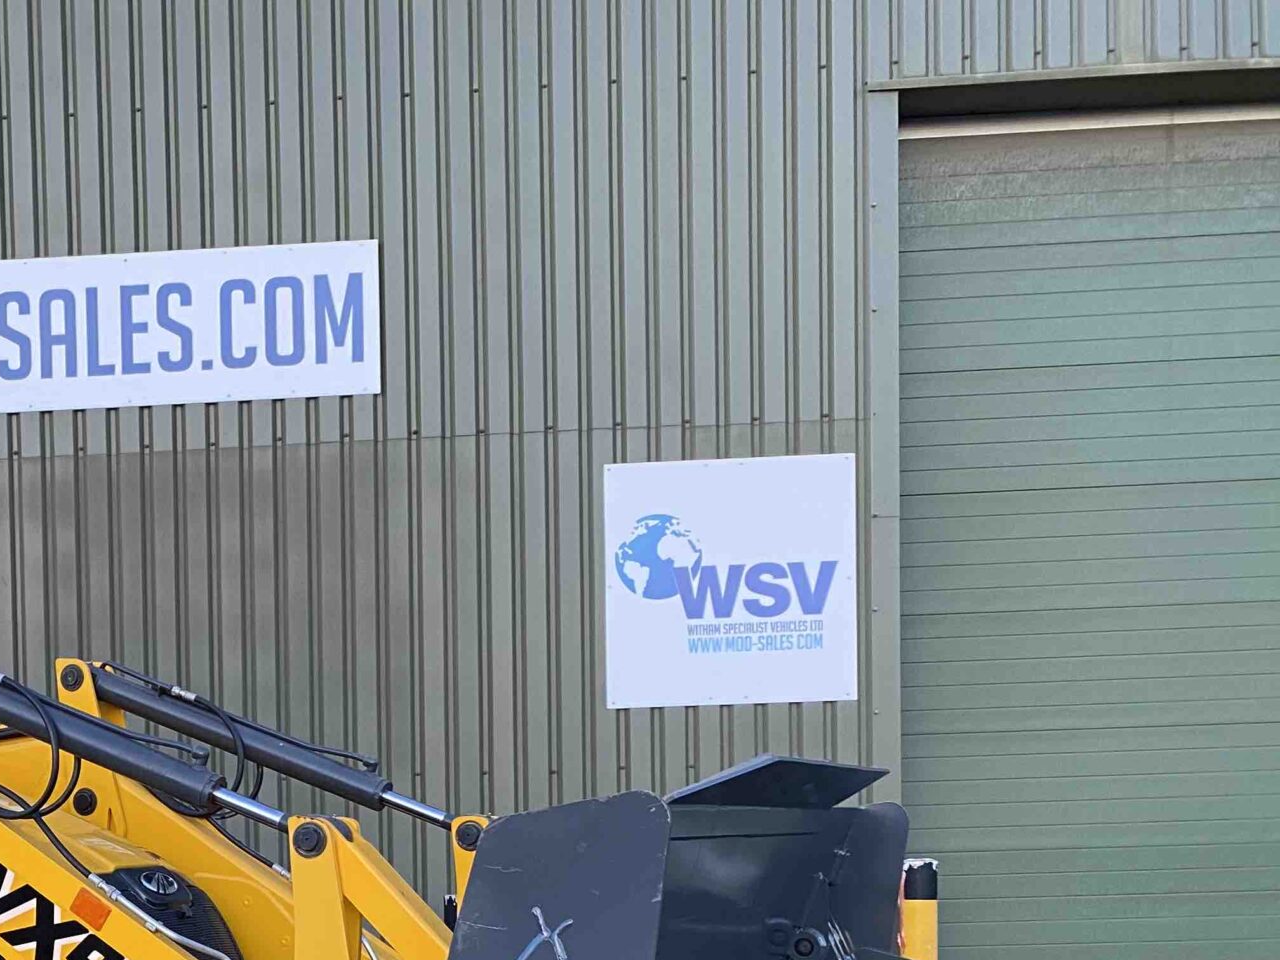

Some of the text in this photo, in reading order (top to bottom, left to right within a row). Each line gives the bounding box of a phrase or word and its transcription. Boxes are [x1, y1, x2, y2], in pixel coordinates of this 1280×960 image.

[673, 560, 839, 620] WSV
[687, 619, 824, 636] WITHAM SPECIALIST VEHICLES LTD
